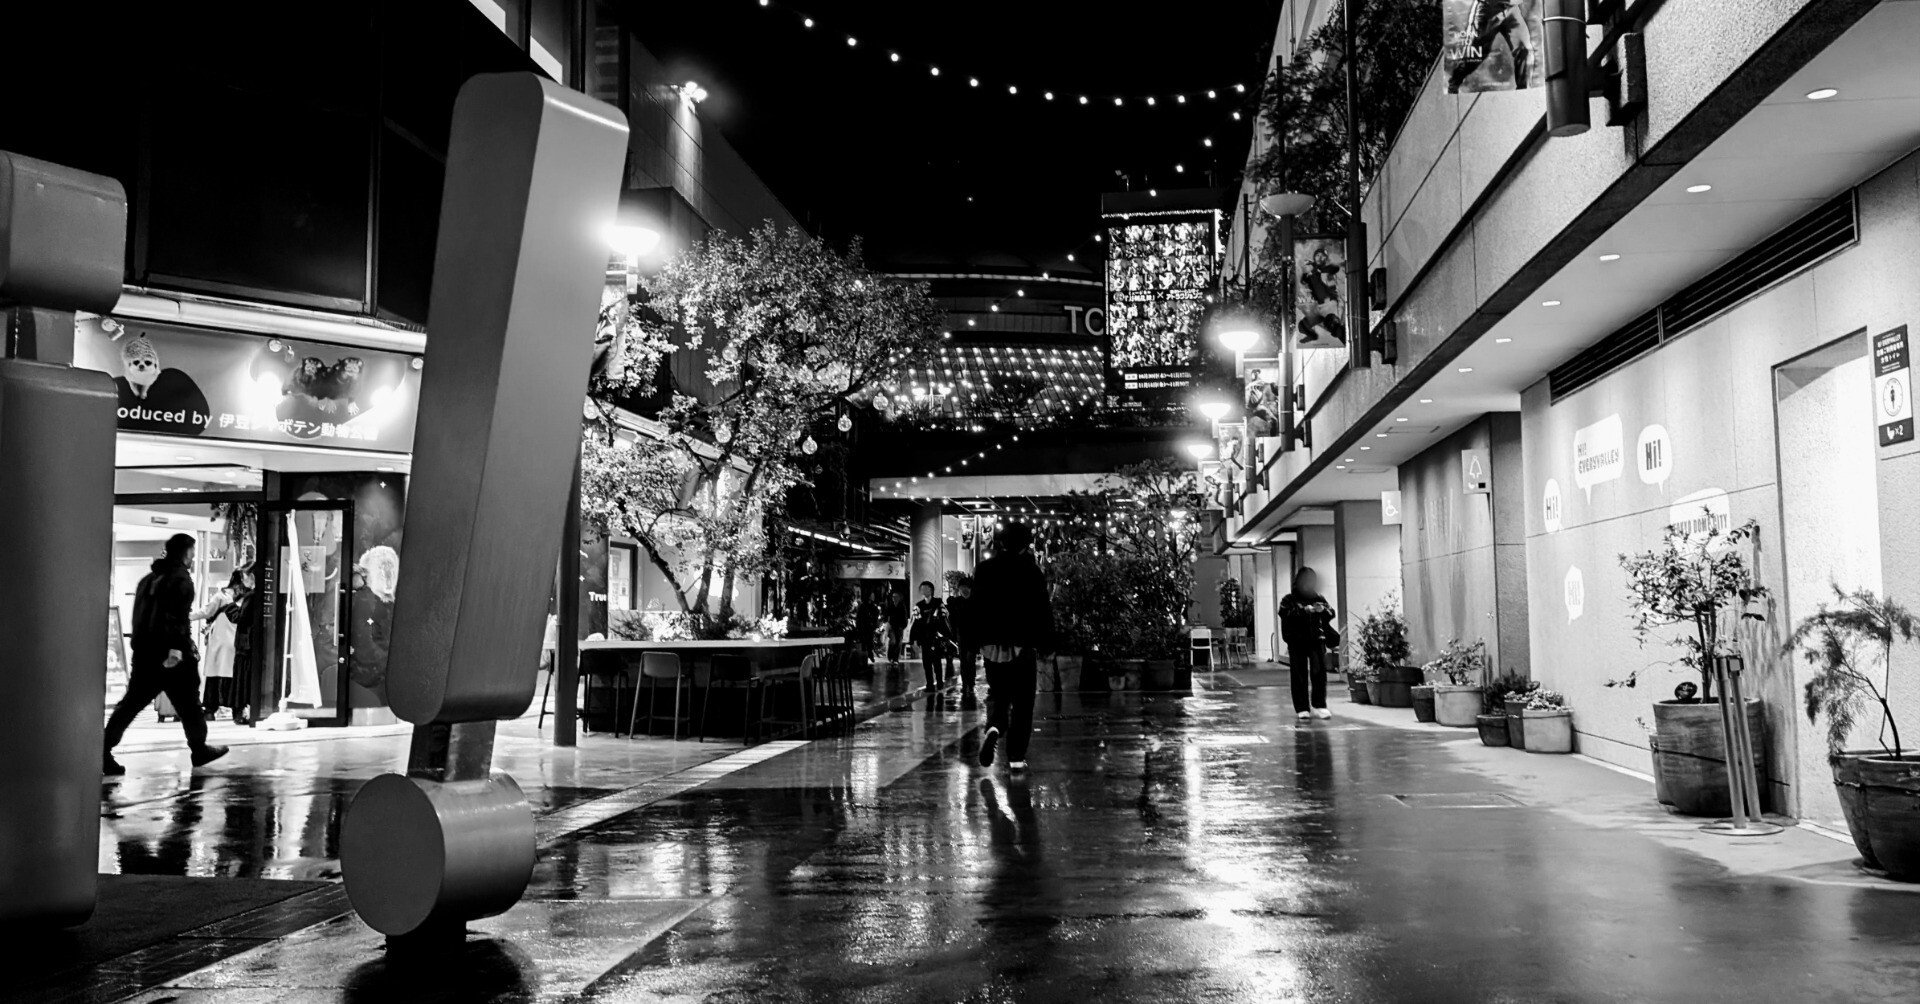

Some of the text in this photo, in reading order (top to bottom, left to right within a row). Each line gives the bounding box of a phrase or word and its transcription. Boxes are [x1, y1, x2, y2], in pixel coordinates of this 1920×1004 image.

[1450, 46, 1482, 60] WIN
[117, 405, 186, 424] oduced
[192, 411, 213, 428] by
[1645, 438, 1663, 471] Hi!
[1546, 495, 1559, 520] Hi!
